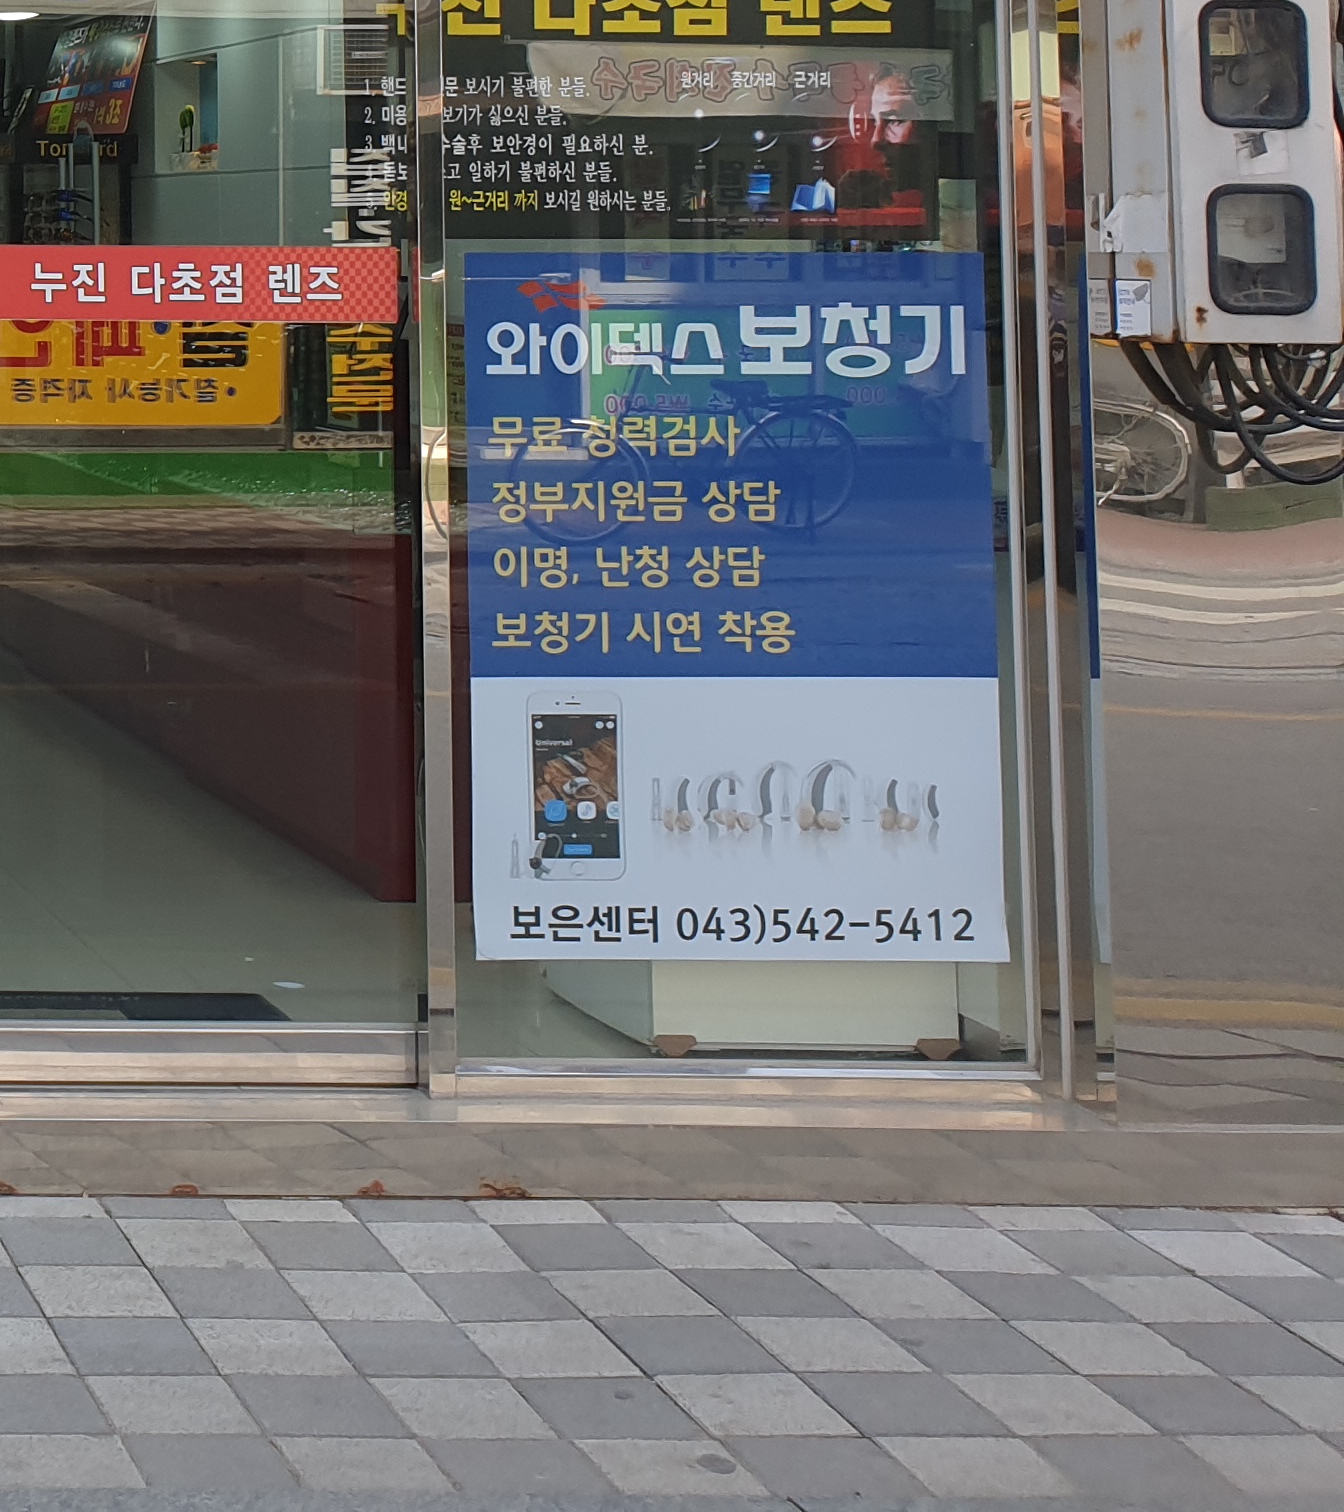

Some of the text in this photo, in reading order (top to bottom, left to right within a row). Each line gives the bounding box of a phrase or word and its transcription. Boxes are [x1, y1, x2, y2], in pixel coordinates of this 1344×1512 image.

[379, 76, 408, 98] 핸드
[463, 75, 505, 98] 보시기
[510, 75, 553, 98] 불편한
[558, 76, 590, 98] 분들.
[679, 70, 714, 89] 원거리
[793, 70, 831, 89] 근거리
[380, 105, 408, 127] 미용
[488, 104, 530, 127] 싫으신
[534, 104, 568, 127] 분들.
[380, 134, 408, 155] 백내
[489, 133, 554, 156] 보안경이
[561, 133, 625, 156] 필요하신
[631, 134, 654, 156] 분.
[382, 161, 408, 183] 돋보
[468, 161, 512, 183] 일하기
[518, 161, 576, 183] 불편하신
[582, 161, 618, 183] 분들.
[382, 190, 408, 212] 안경
[513, 190, 539, 212] 까지
[543, 190, 582, 212] 보시길
[586, 190, 638, 212] 원하시는
[641, 190, 672, 212] 분들.
[29, 261, 345, 304] 누진 다초점 렌즈
[485, 301, 968, 378] 와이덱스 보청기
[487, 415, 741, 459] 무료 청력검사
[490, 480, 782, 524] 정부지원금 상담
[493, 545, 767, 589] 이명, 난청 상담
[490, 610, 797, 656] 보청기 시연 착용
[510, 904, 976, 946] 보은센터 043)542-5412
